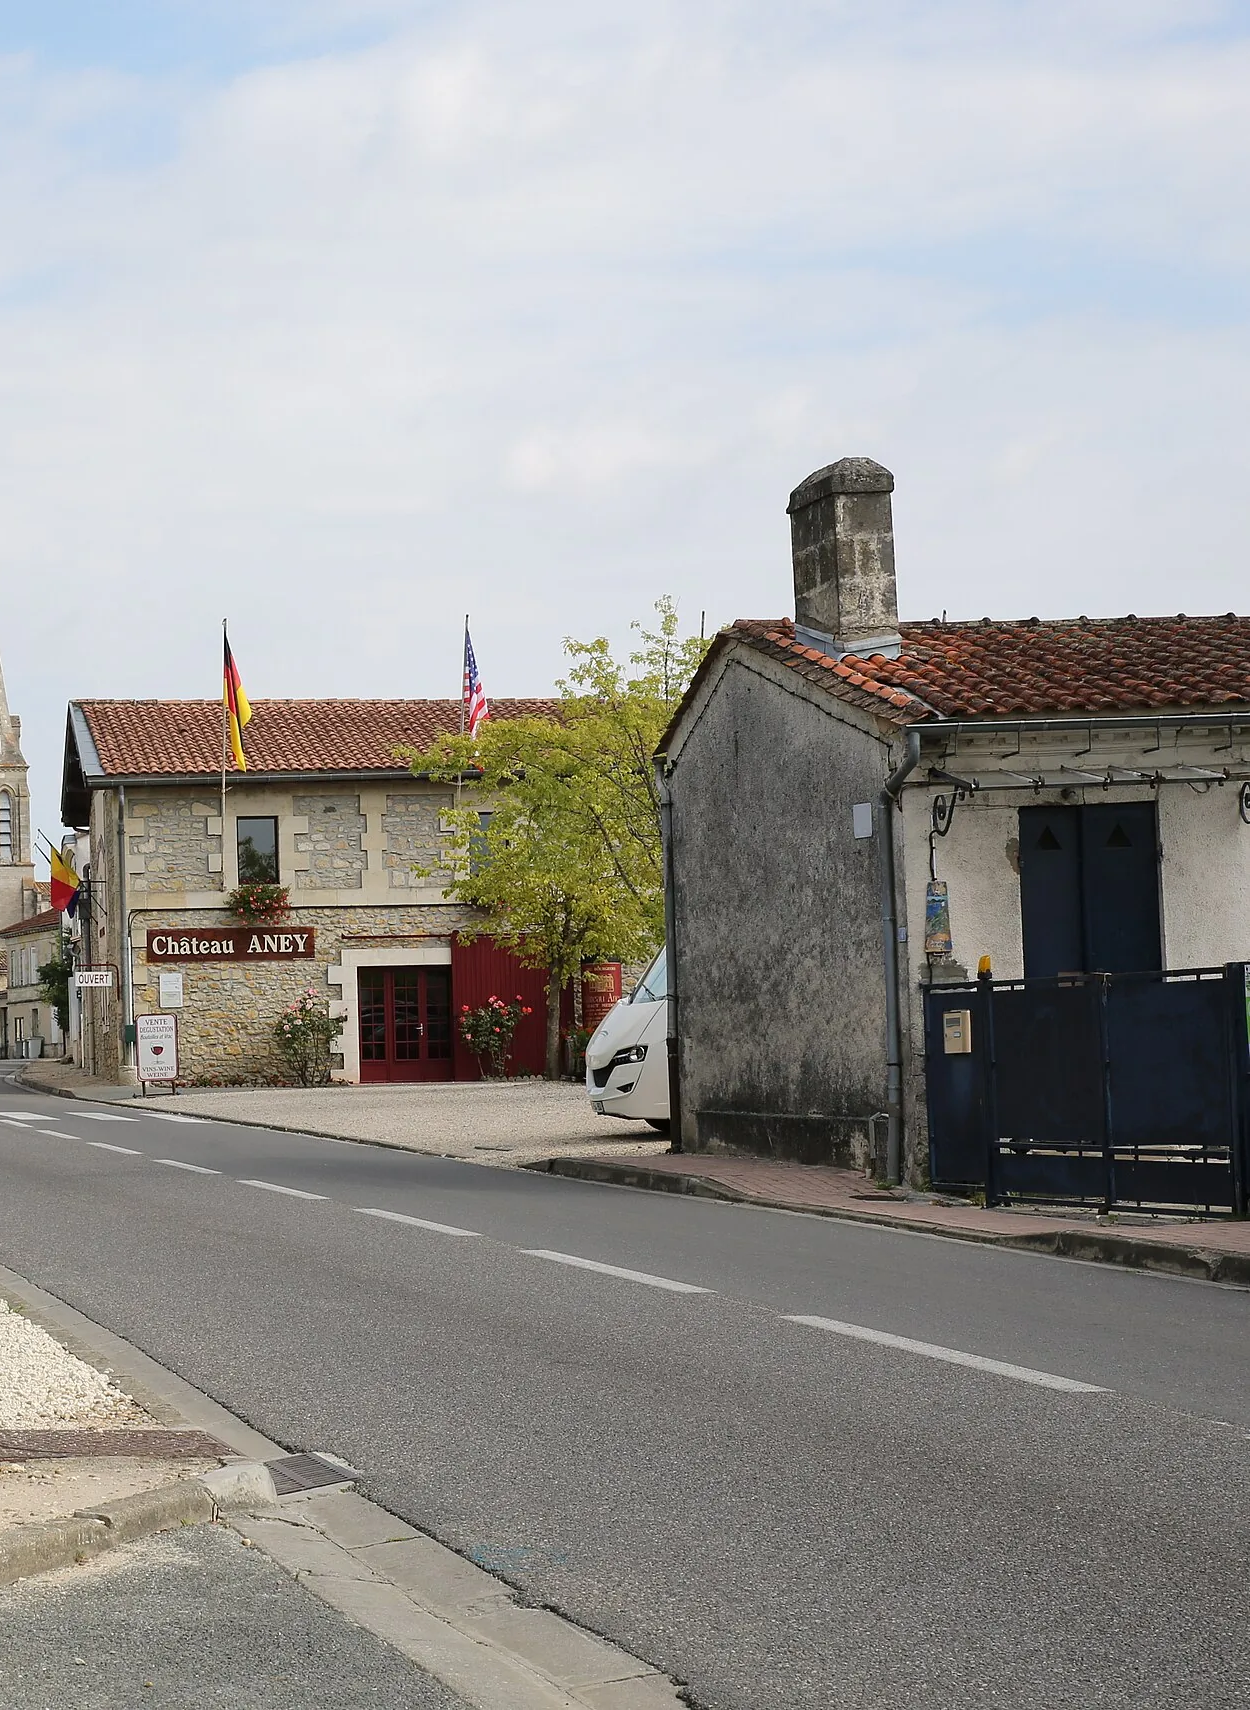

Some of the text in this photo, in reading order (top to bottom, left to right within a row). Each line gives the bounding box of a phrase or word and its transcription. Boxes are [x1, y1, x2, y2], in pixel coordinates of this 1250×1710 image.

[151, 934, 309, 955] Château ANEY
[78, 974, 109, 984] OUVERT
